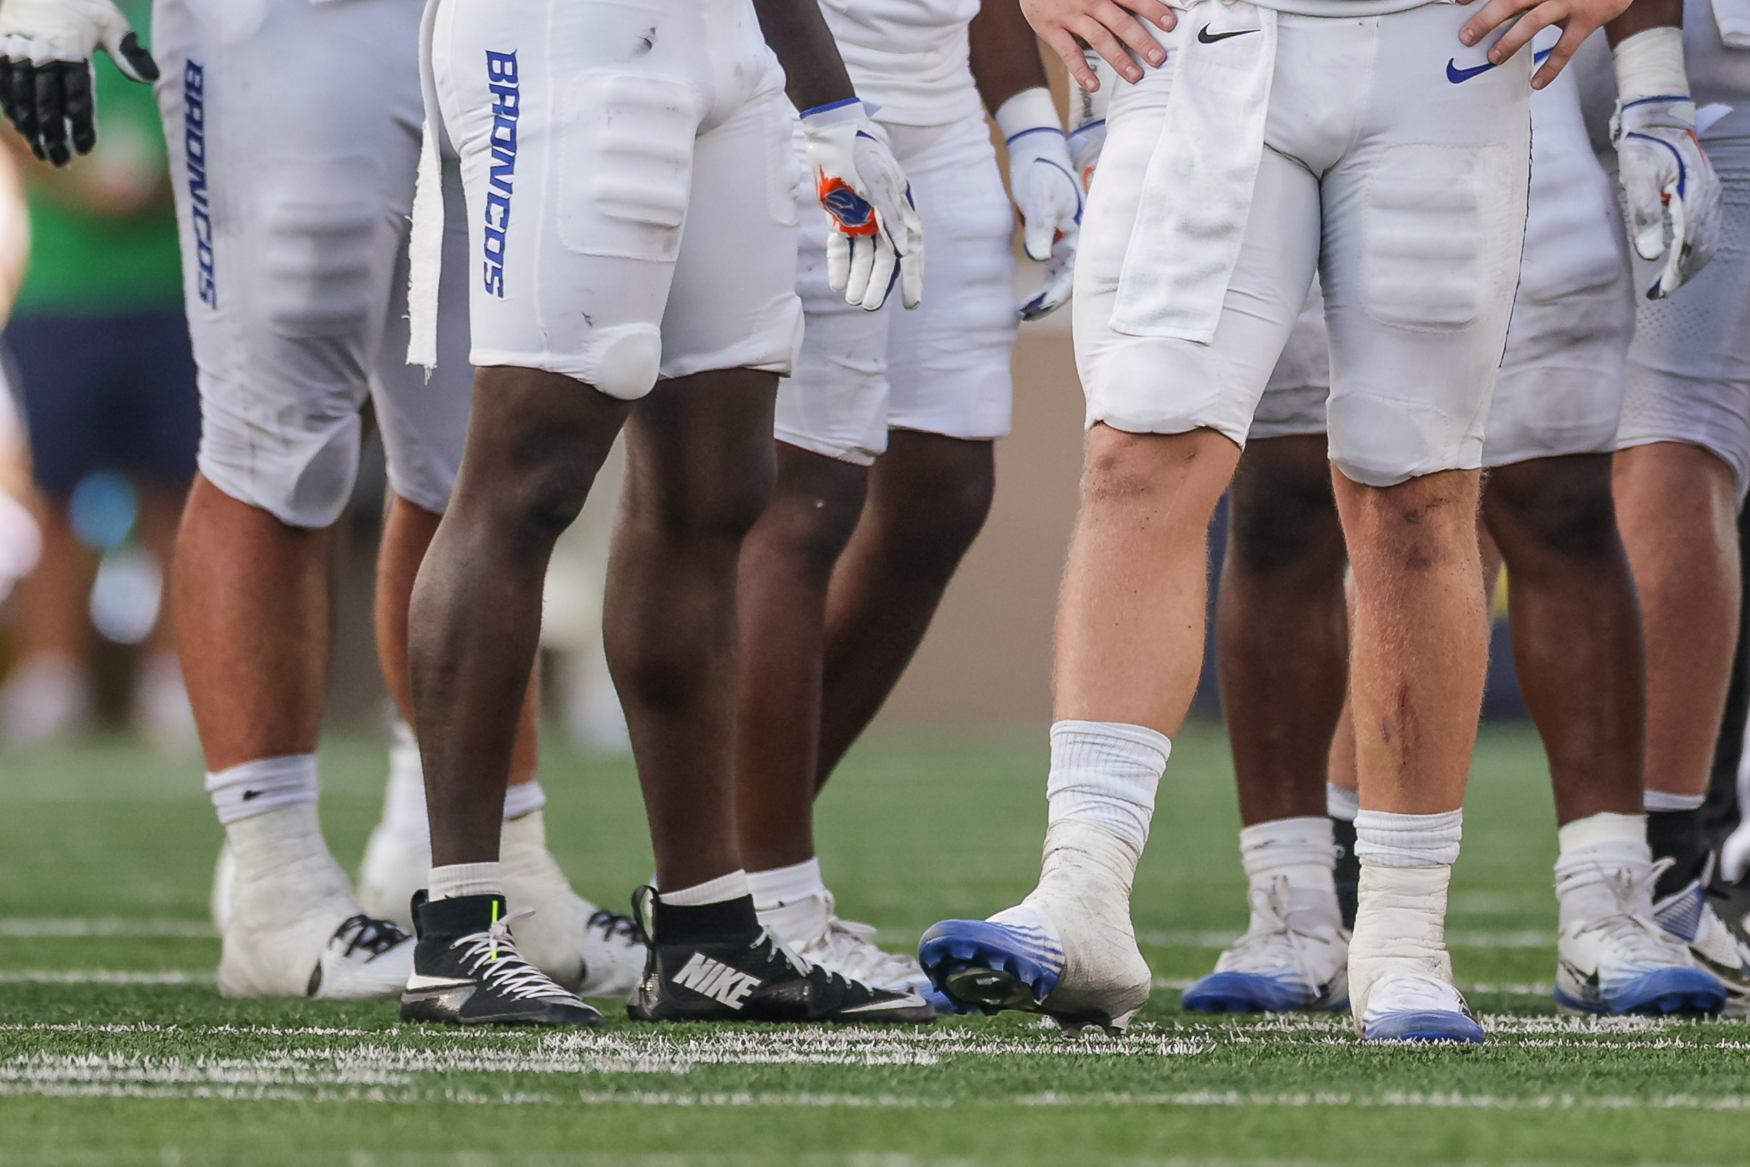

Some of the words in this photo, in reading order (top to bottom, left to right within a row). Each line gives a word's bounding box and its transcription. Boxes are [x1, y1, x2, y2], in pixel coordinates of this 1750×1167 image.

[184, 58, 217, 311] BRONCOS
[484, 48, 520, 299] BRONCOS
[672, 951, 763, 1010] NIKE
